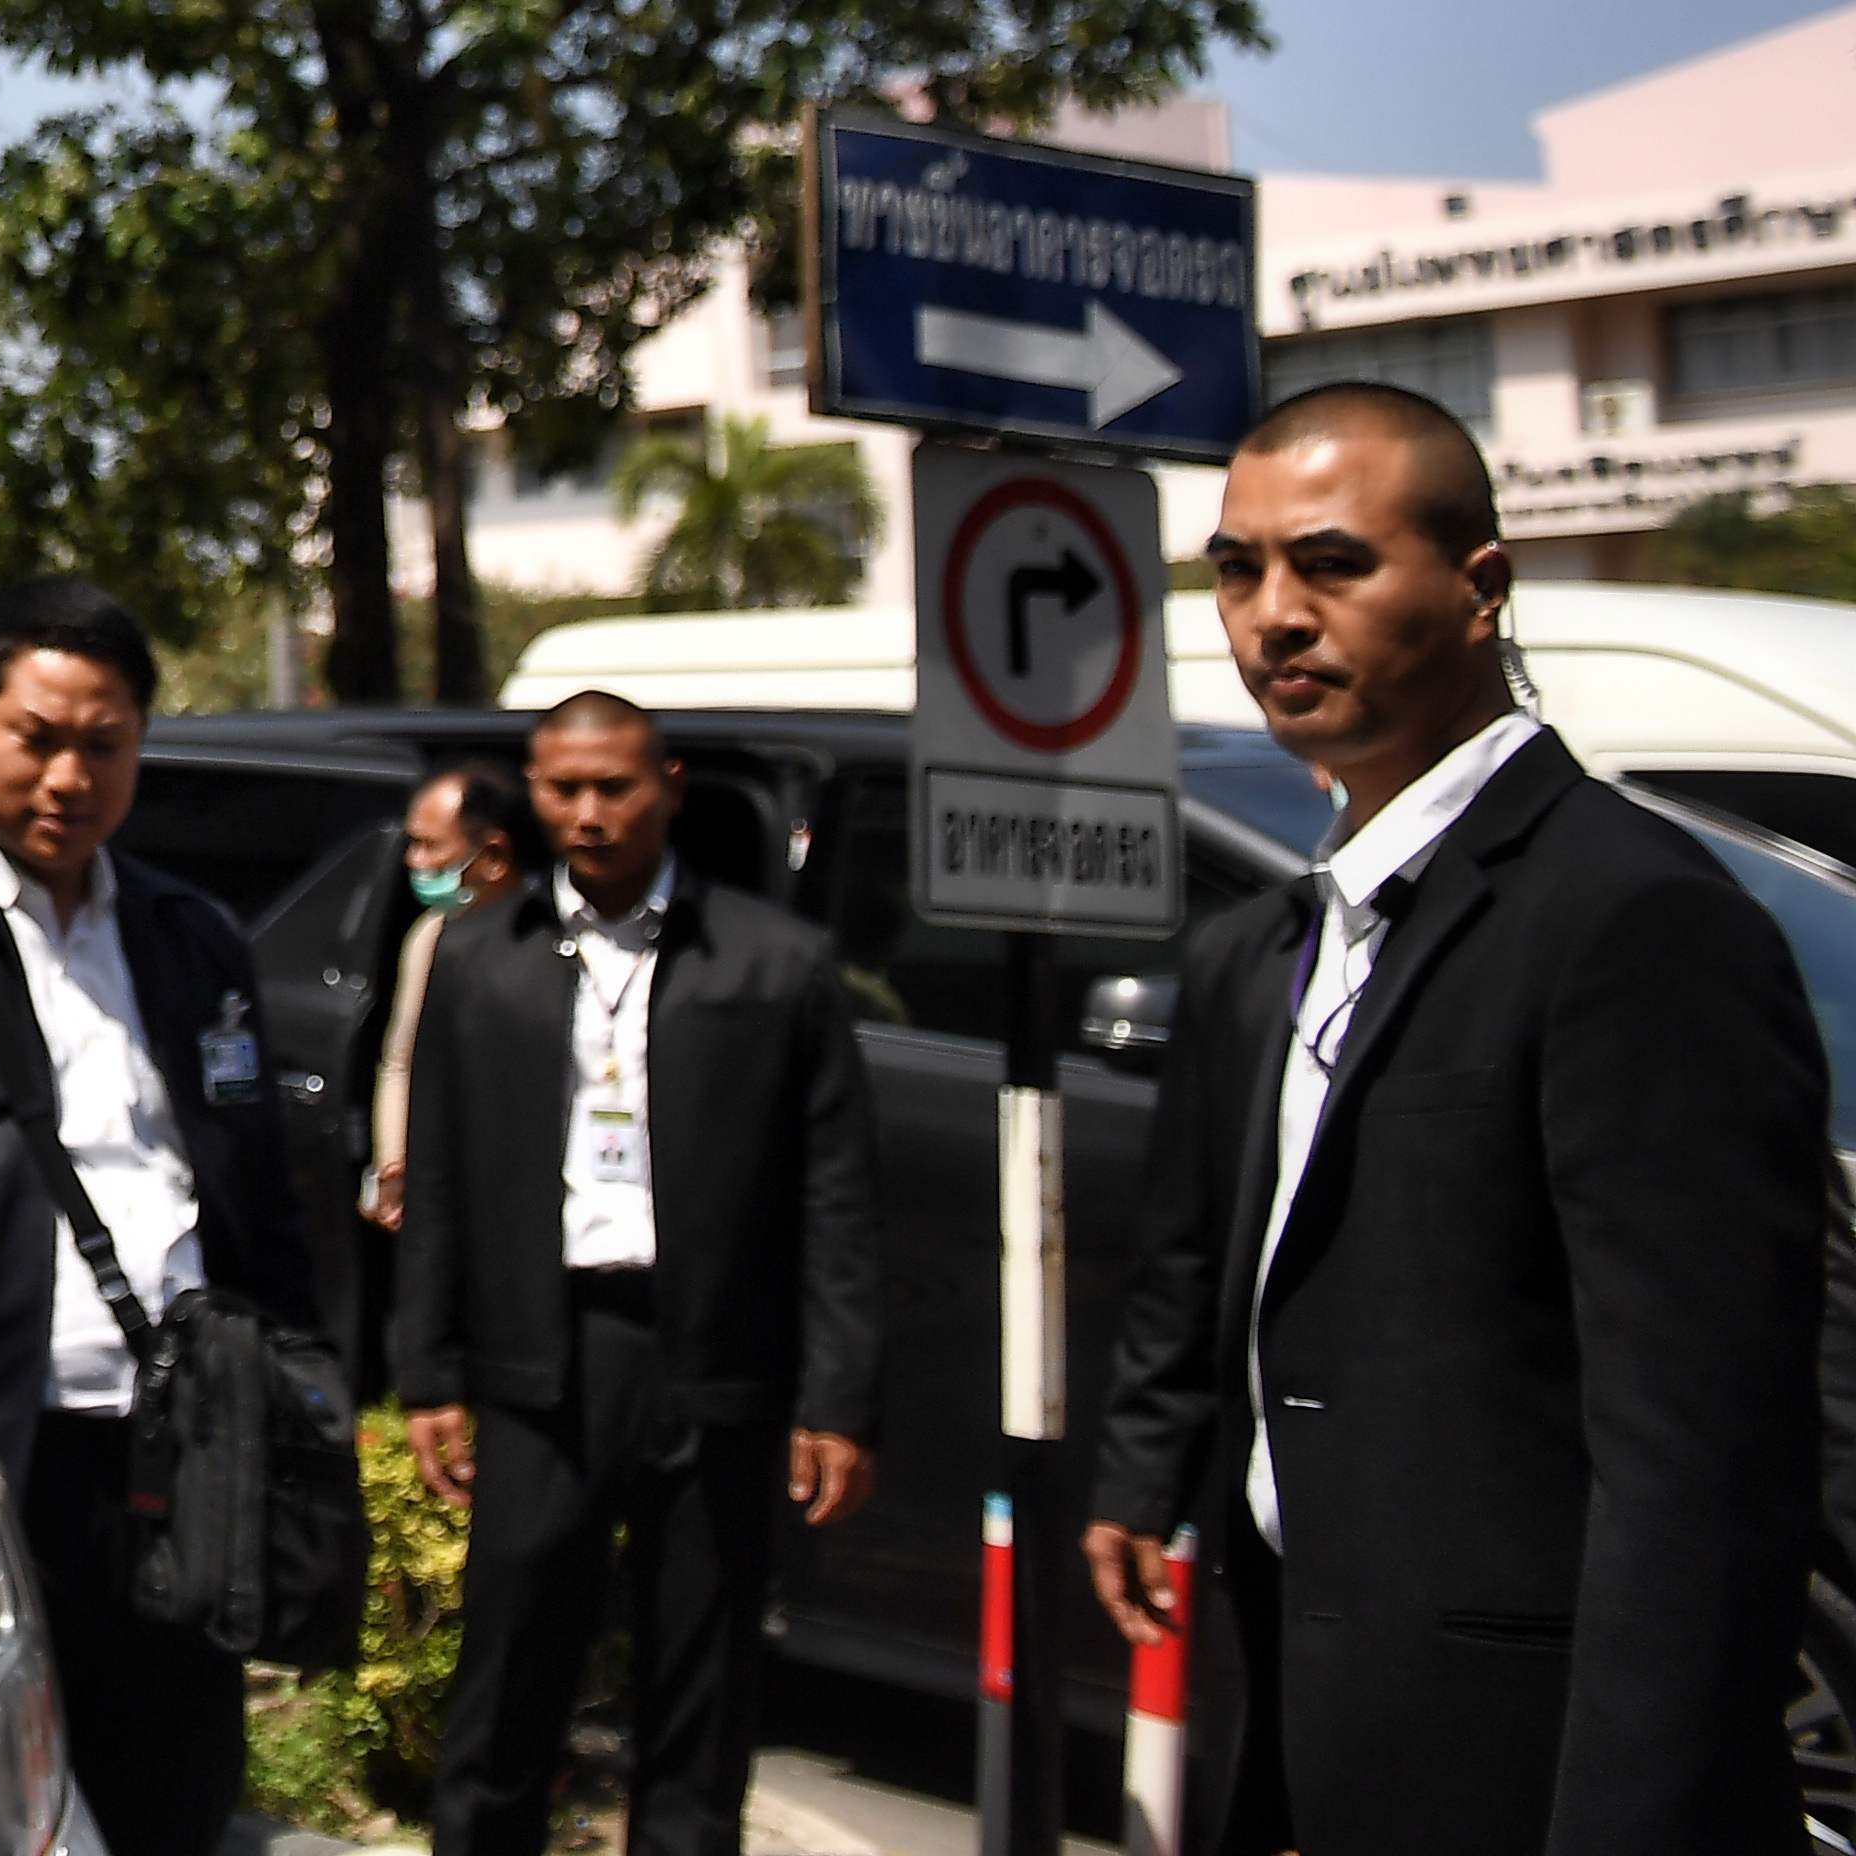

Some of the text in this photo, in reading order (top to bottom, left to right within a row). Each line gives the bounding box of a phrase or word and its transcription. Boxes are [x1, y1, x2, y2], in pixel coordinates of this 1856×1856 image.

[840, 147, 1248, 309] ทางขึ้นอาคารจอดรถ
[943, 811, 1160, 889] อาคารจอดรถ
